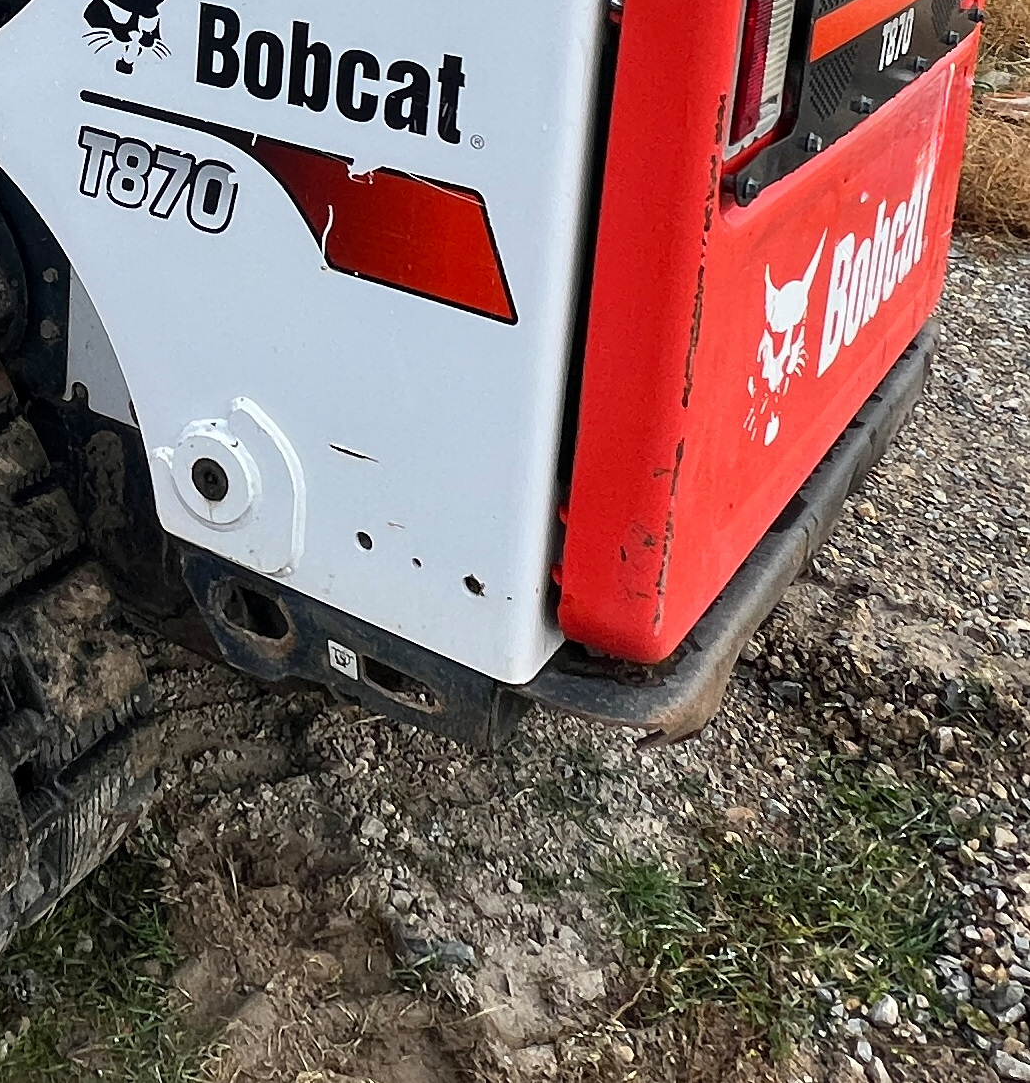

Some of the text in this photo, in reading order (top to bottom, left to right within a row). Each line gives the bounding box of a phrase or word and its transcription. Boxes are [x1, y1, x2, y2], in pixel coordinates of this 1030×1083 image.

[195, 1, 466, 145] Bobcat
[878, 7, 915, 72] T870
[78, 125, 239, 234] T870
[816, 176, 931, 379] Bobcat
